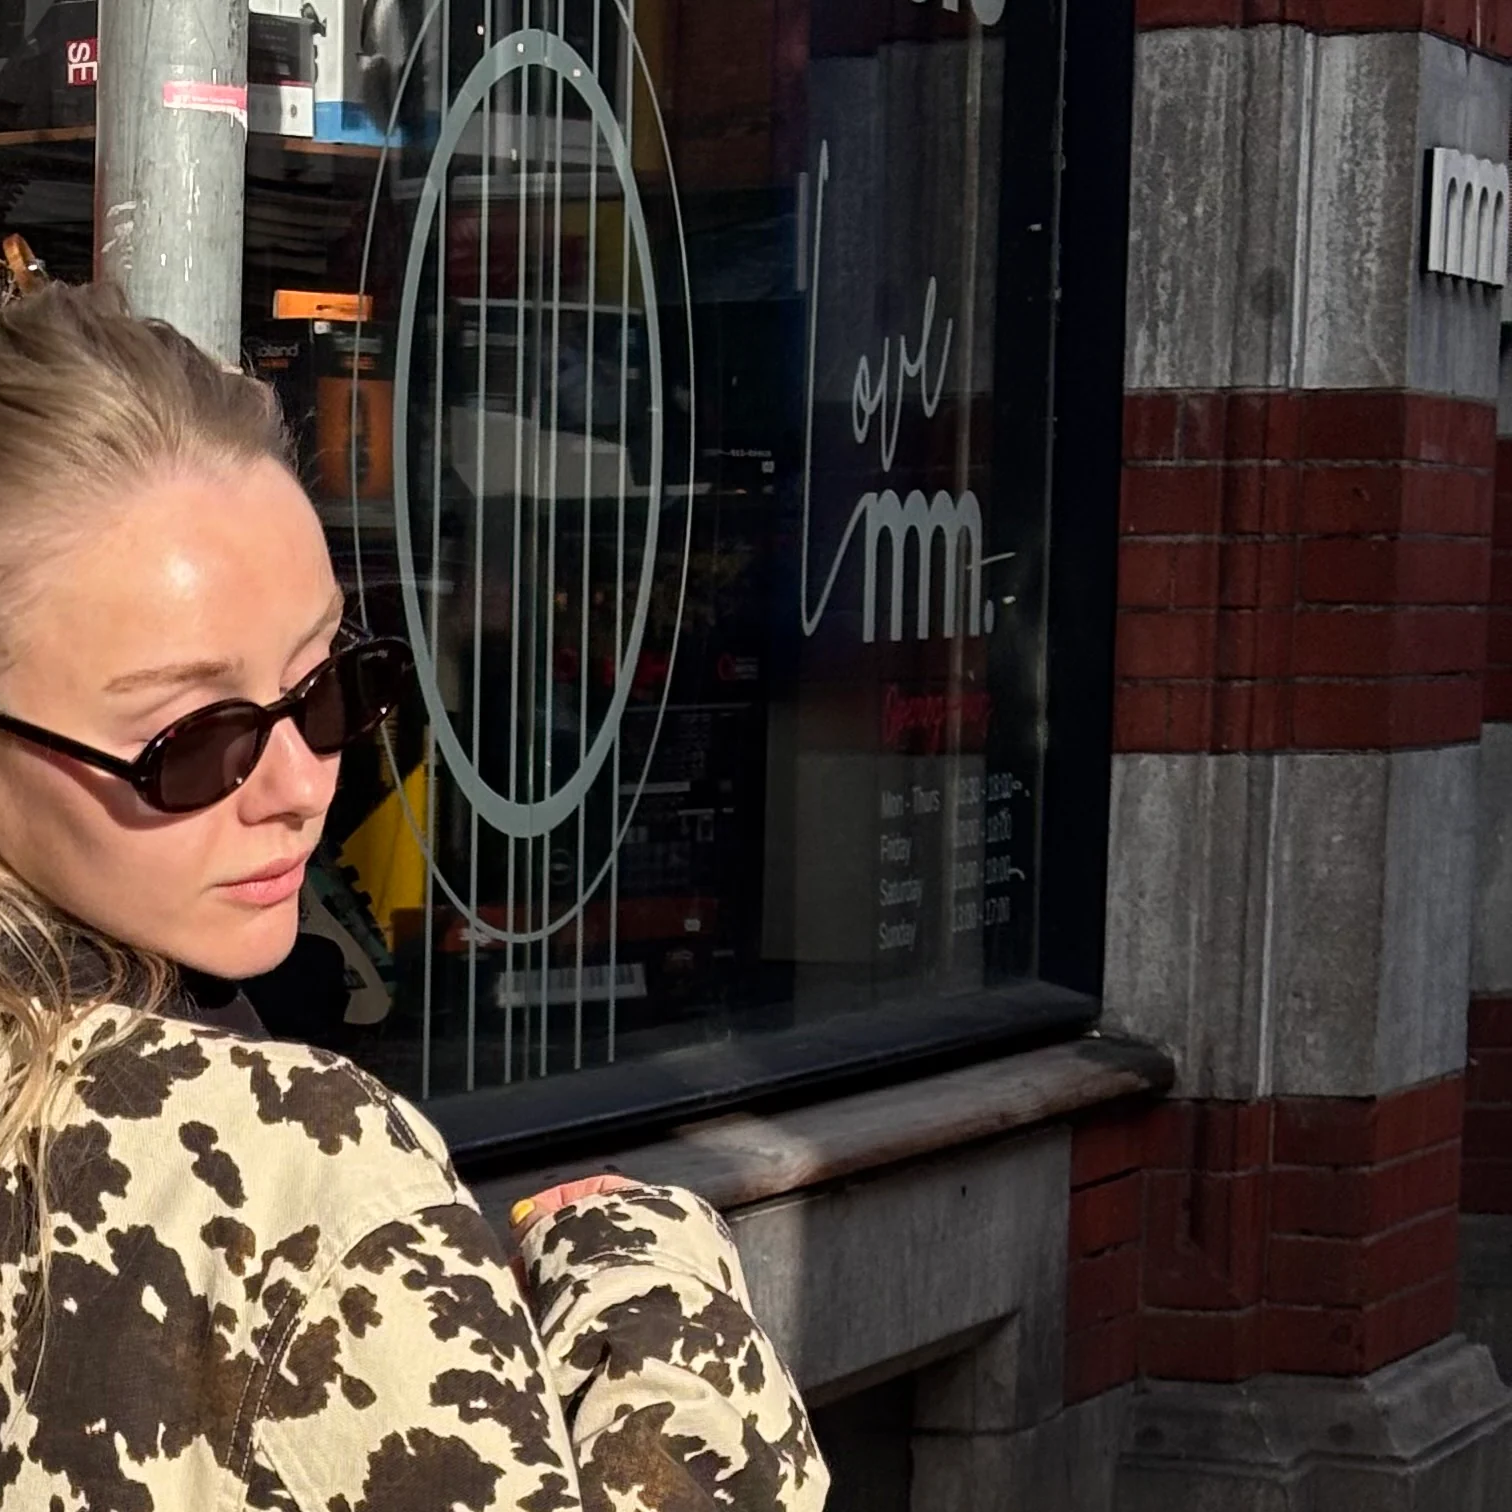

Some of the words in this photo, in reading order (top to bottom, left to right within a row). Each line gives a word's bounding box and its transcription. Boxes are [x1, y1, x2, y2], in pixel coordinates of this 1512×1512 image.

[881, 790, 904, 818] Mon
[912, 786, 941, 815] Thurs
[880, 833, 912, 866] Friday
[880, 876, 924, 907] Saturday
[879, 918, 917, 952] Sunday
